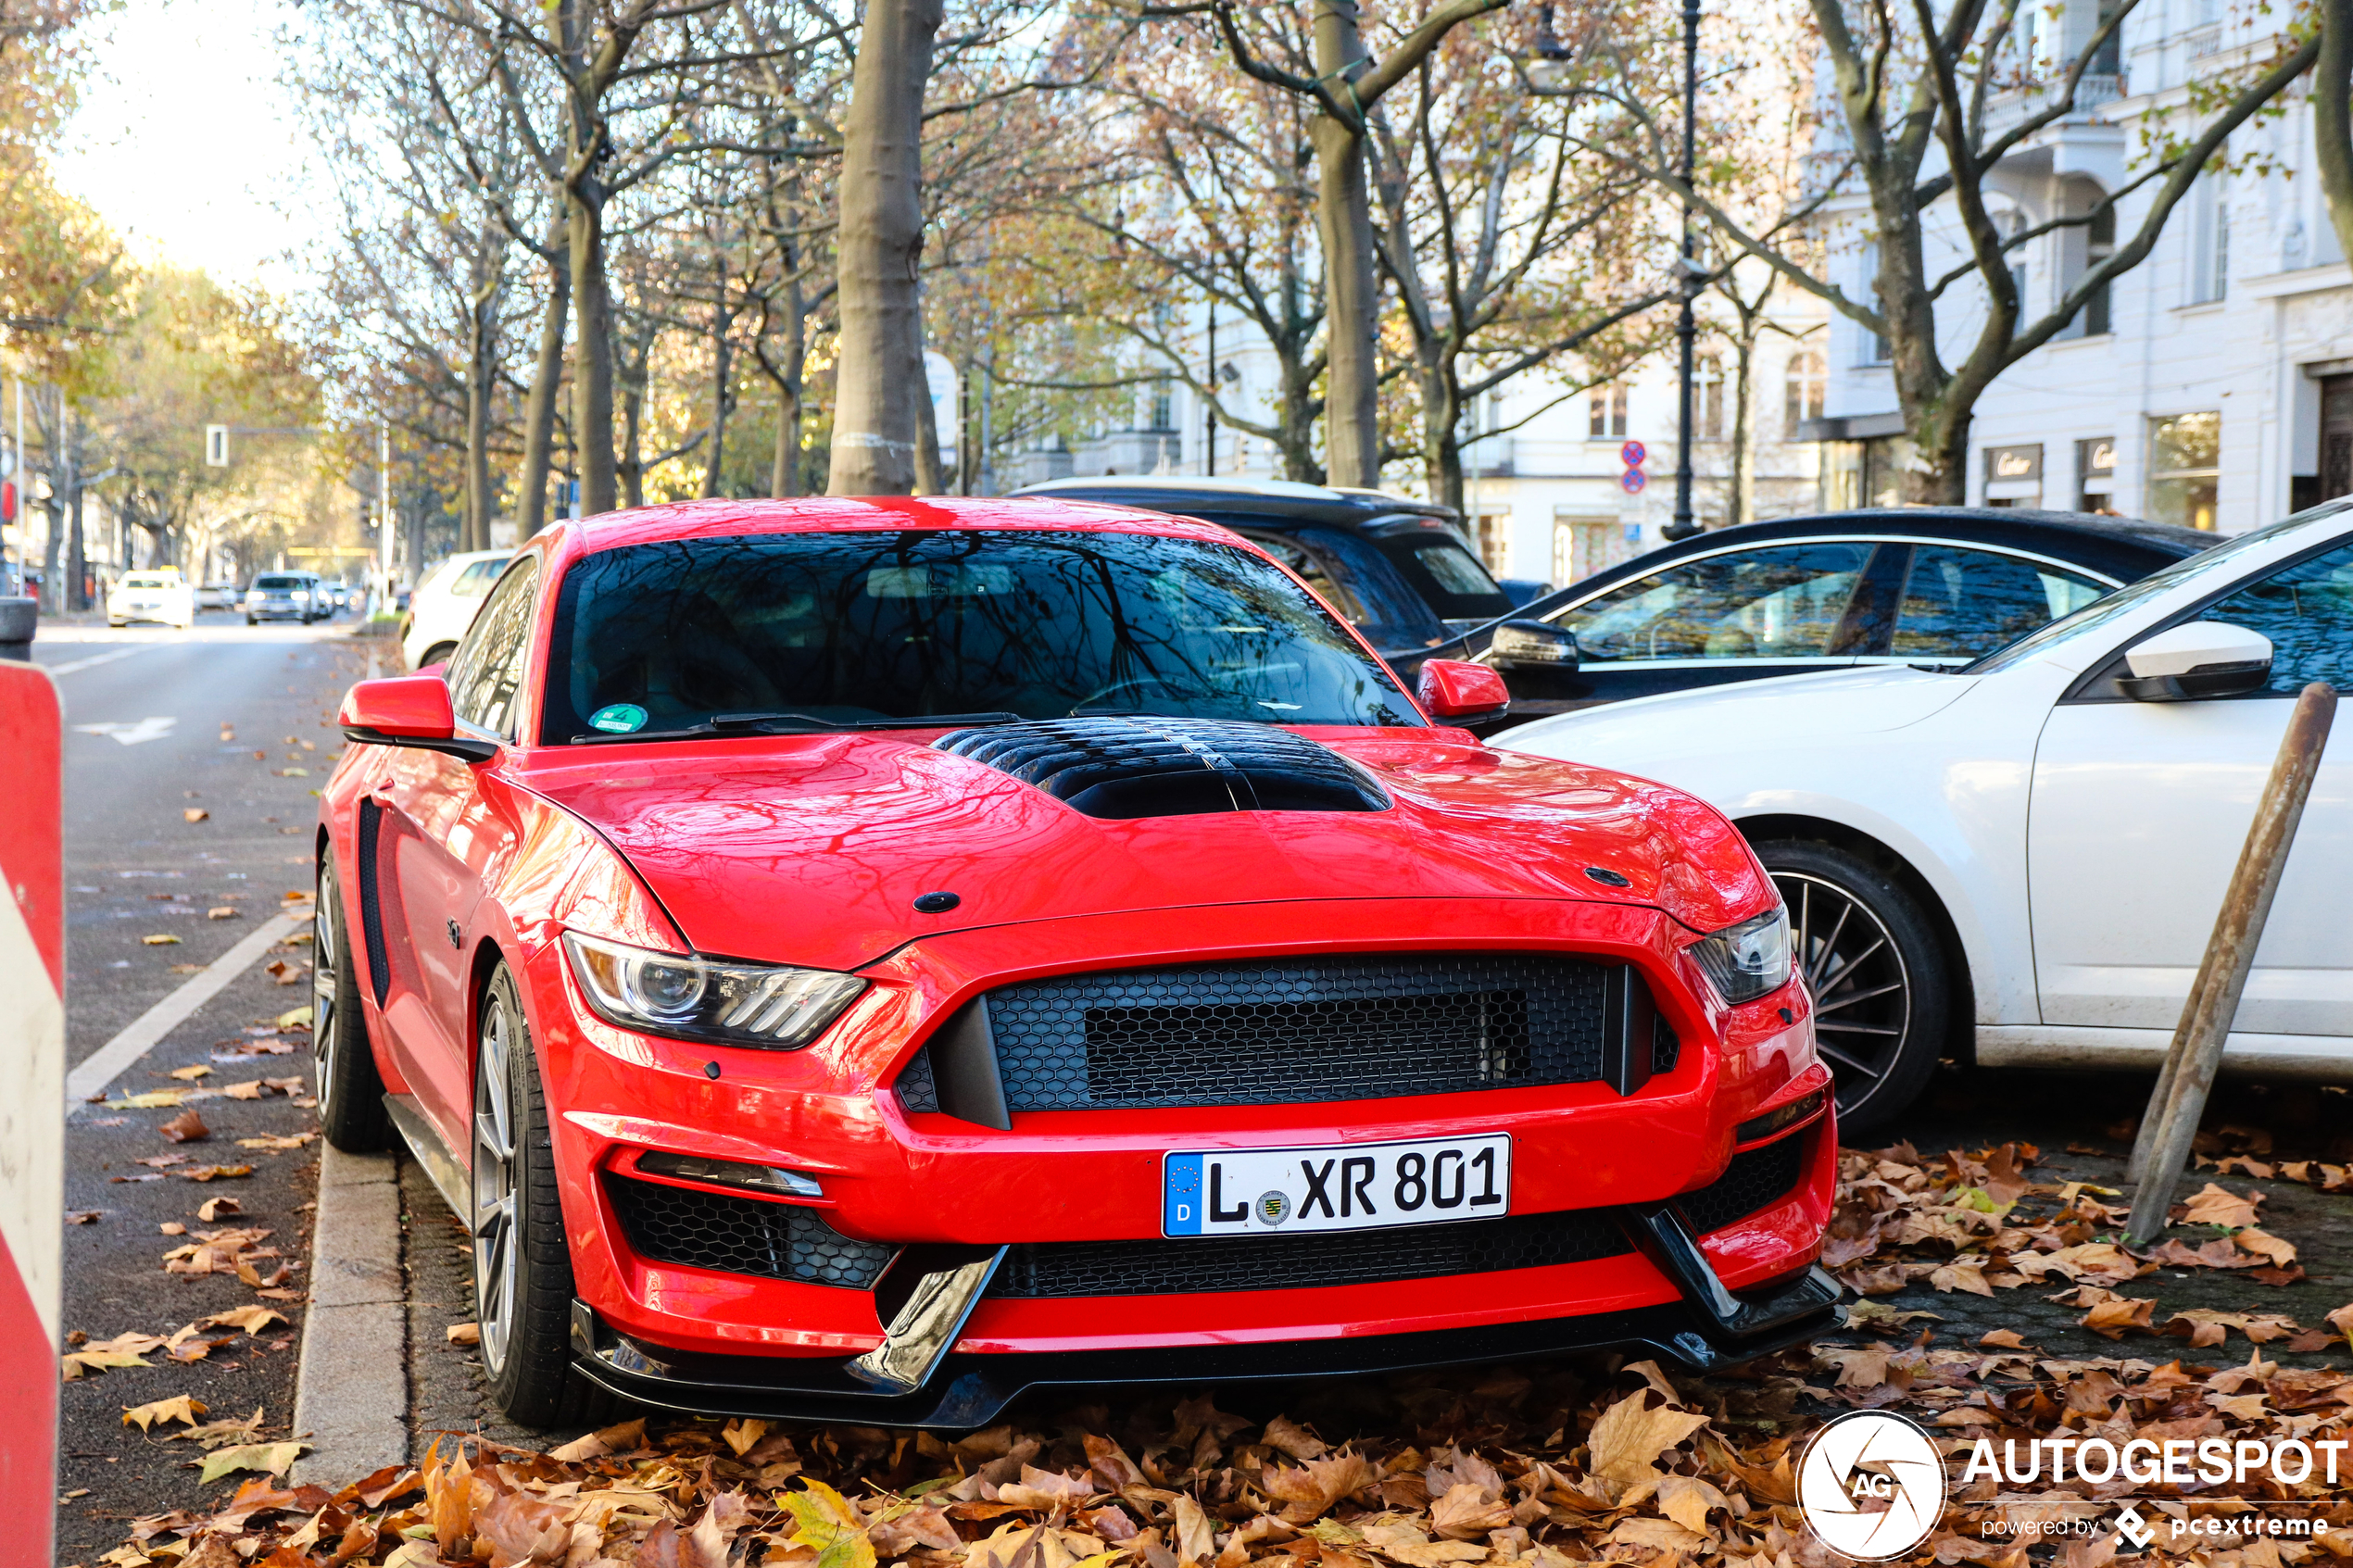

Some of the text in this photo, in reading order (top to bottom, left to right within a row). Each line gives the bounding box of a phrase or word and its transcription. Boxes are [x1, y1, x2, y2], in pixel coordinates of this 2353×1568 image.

[1209, 1146, 1503, 1223] L XR 801
[1176, 1203, 1190, 1222] D
